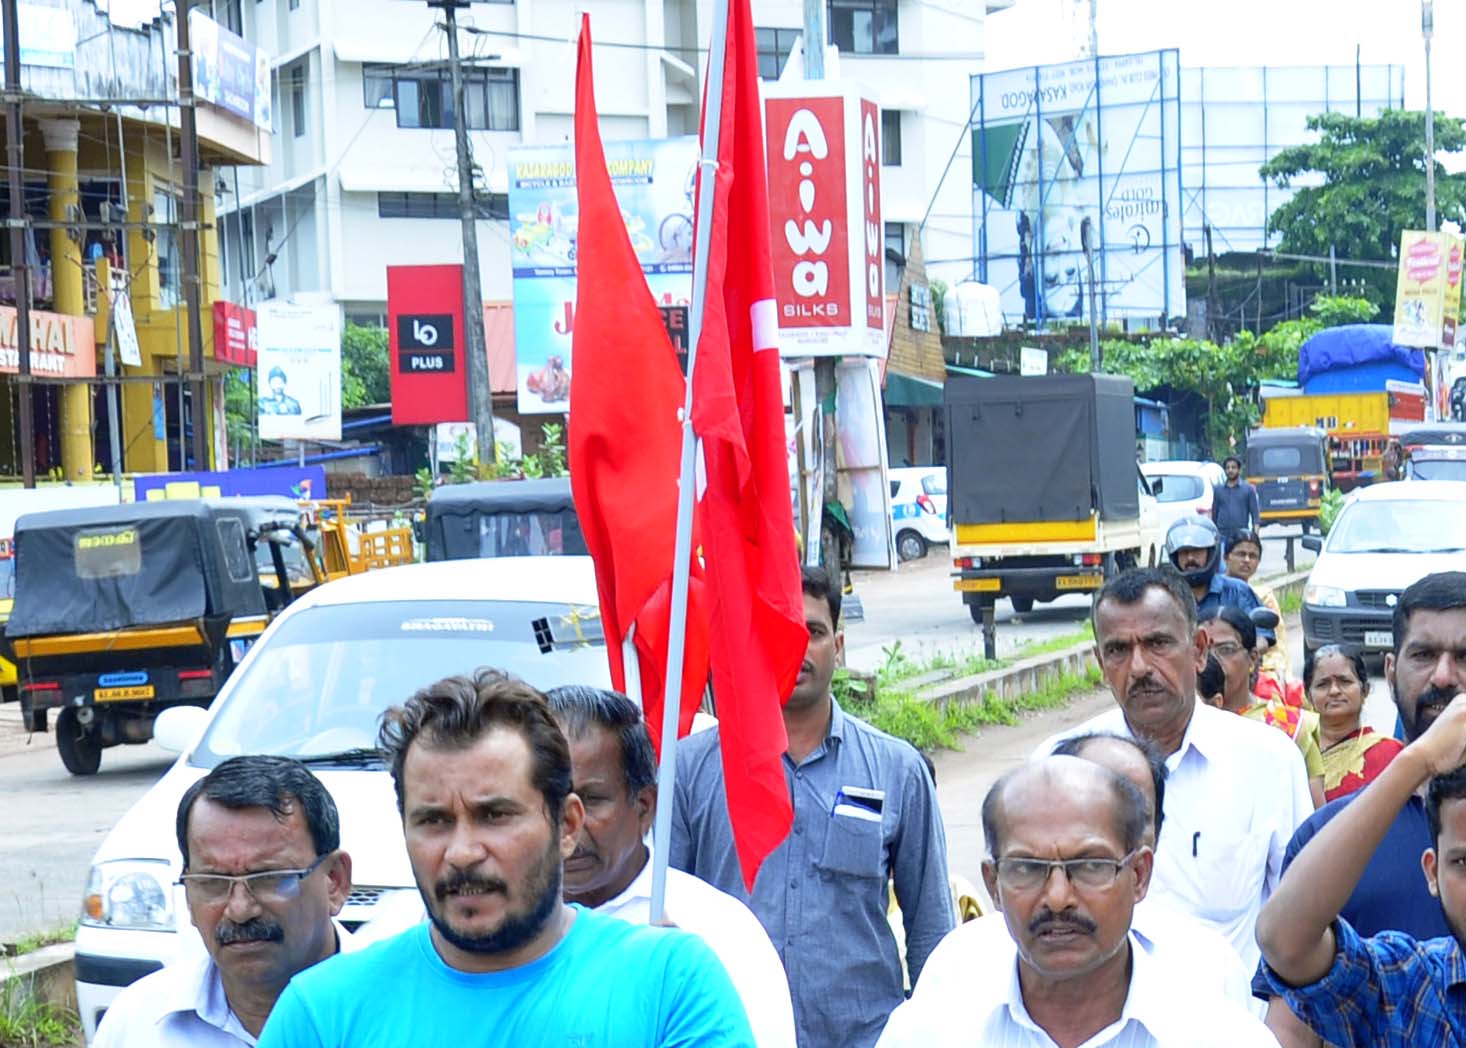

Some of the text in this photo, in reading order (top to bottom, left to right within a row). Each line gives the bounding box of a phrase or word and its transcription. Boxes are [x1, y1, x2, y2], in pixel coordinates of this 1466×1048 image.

[1001, 86, 1067, 109] KASAAGOD
[783, 303, 839, 318] SILKS
[411, 356, 444, 369] PLUS
